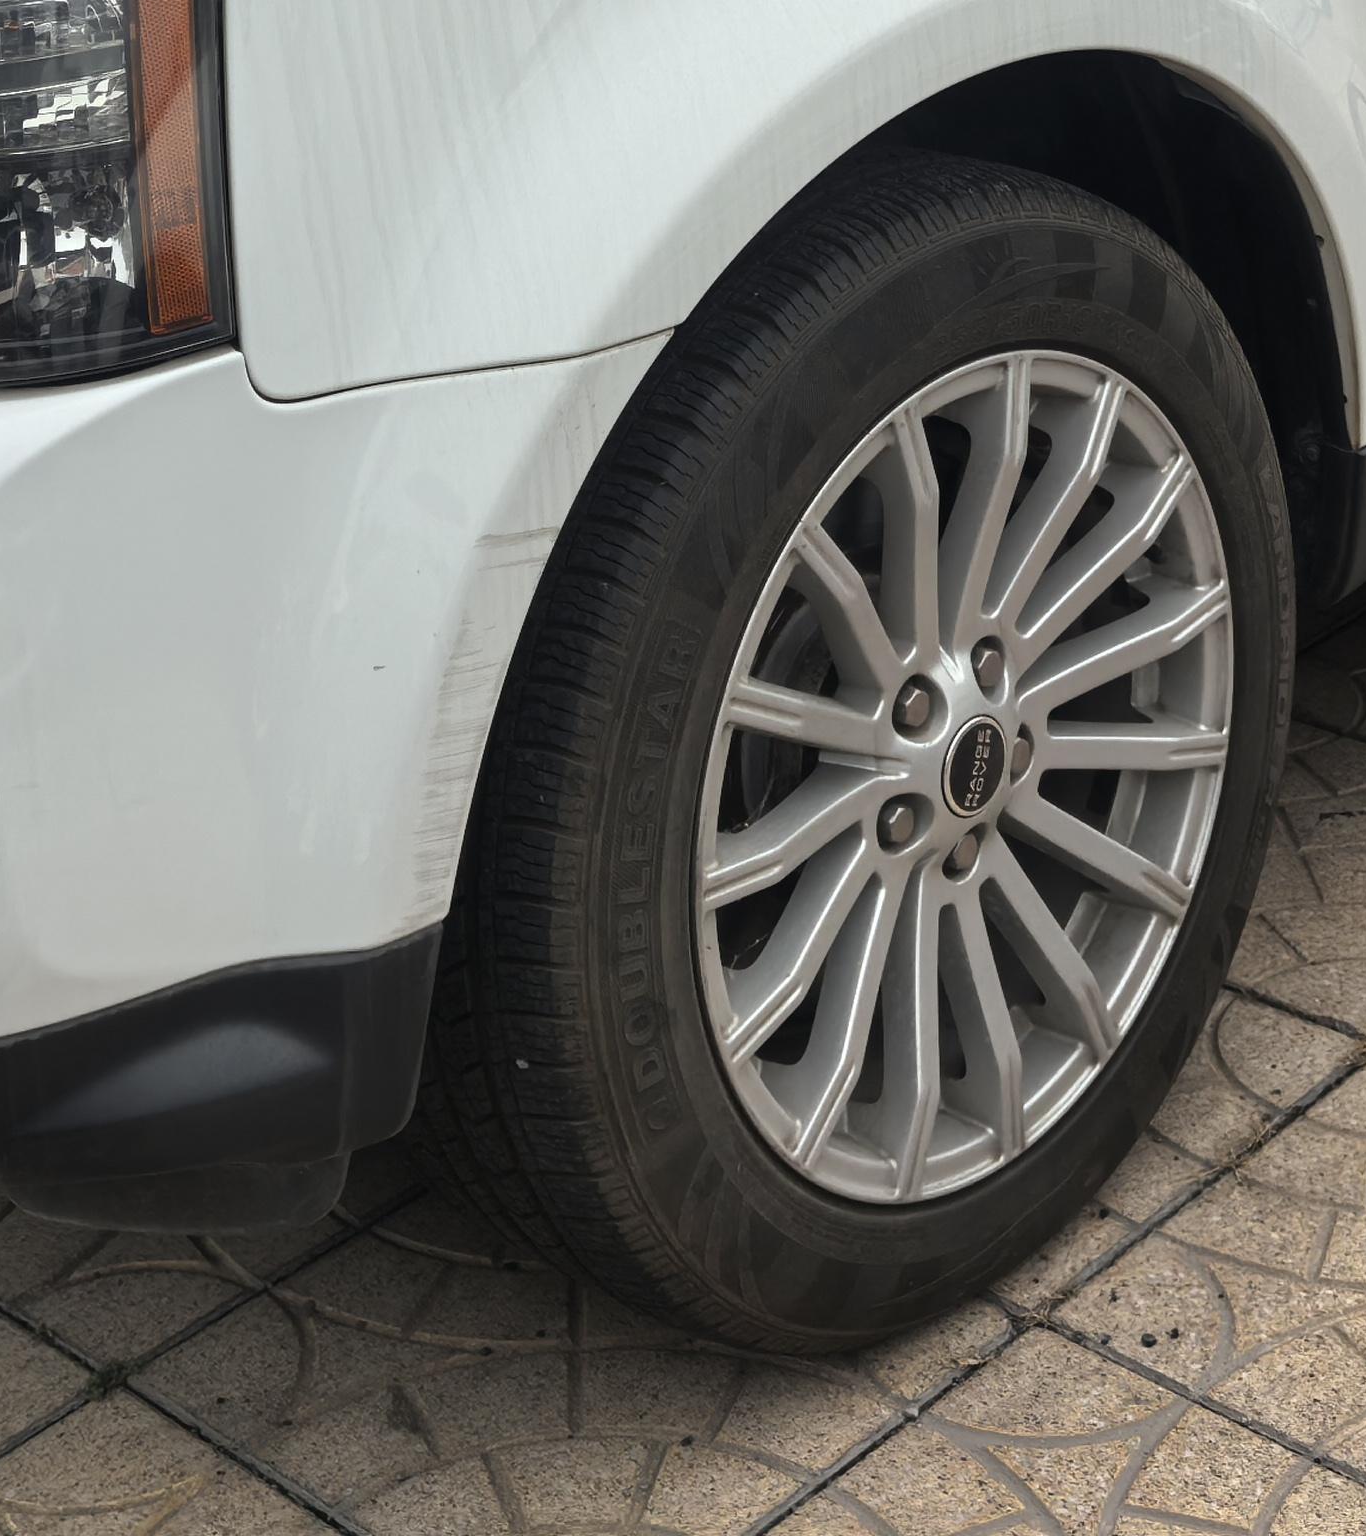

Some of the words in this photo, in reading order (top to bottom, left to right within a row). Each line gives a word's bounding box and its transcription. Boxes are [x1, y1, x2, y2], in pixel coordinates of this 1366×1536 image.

[964, 728, 985, 807] RANGE
[971, 727, 992, 807] ROVER
[615, 632, 699, 1094] DOUBLESTAR
